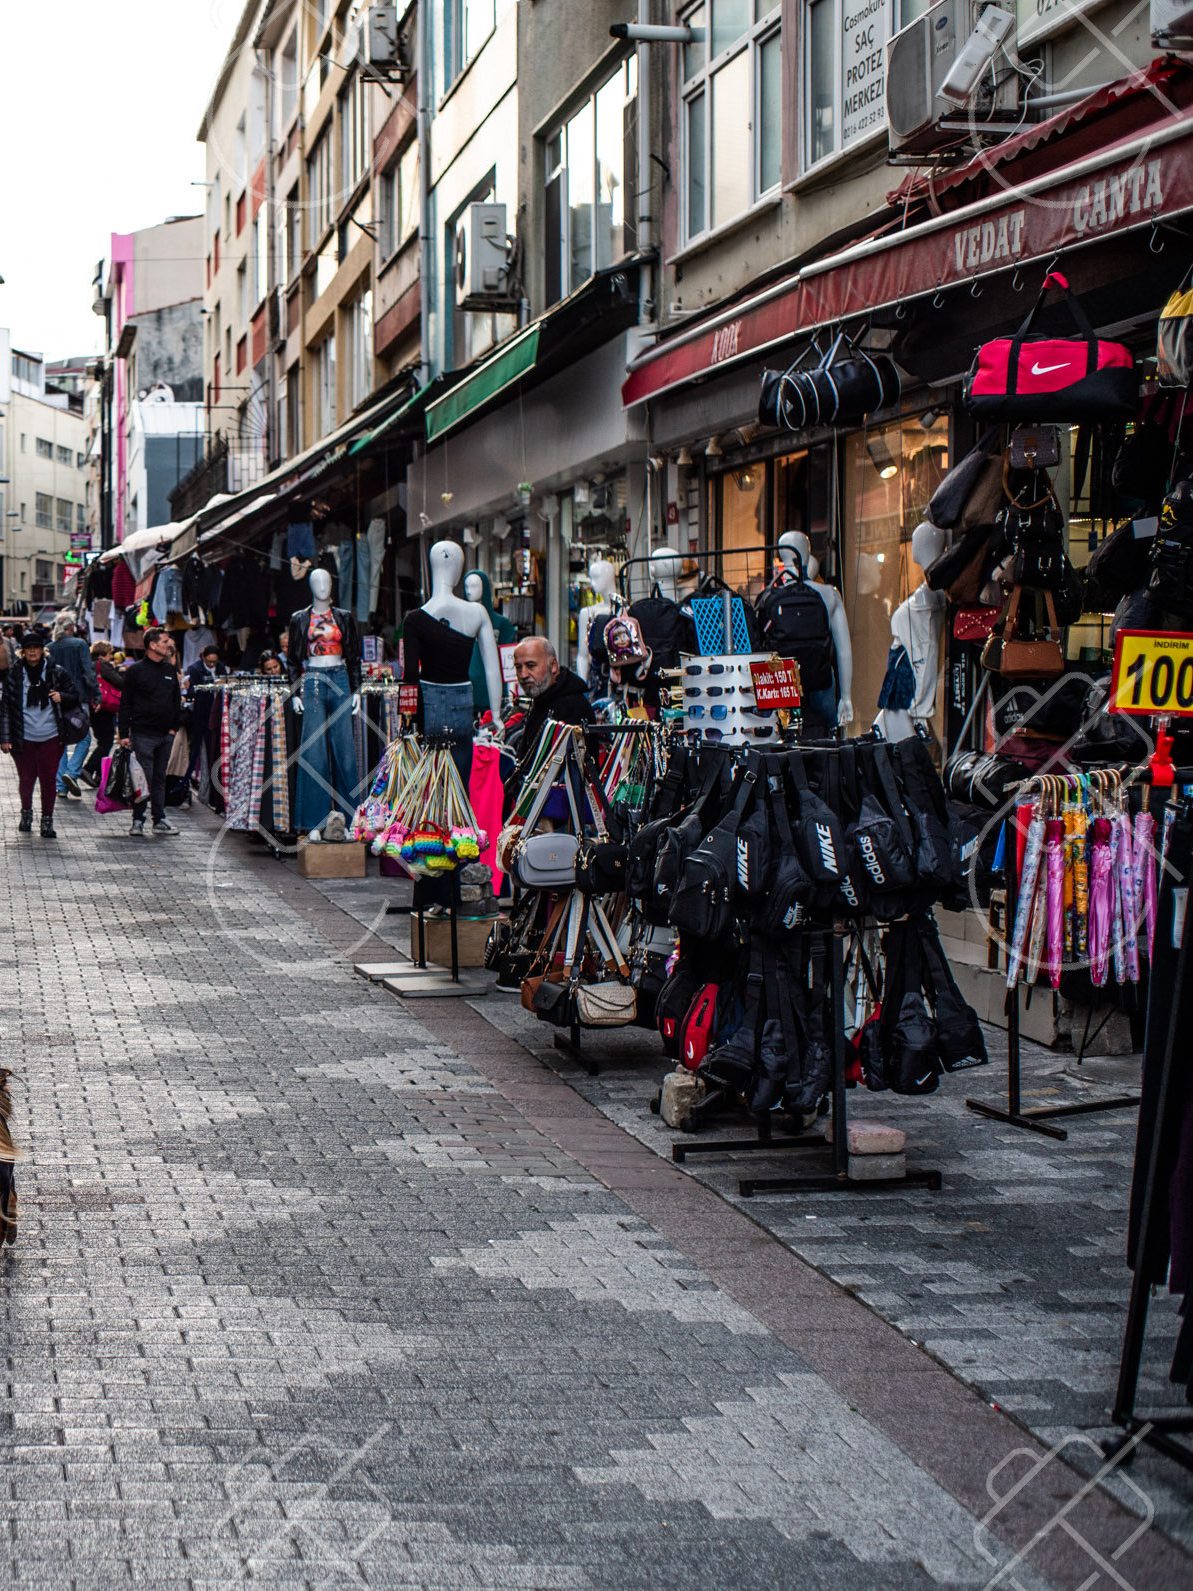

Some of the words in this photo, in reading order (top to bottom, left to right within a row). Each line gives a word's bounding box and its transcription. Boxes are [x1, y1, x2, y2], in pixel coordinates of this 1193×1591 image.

[855, 24, 874, 53] SAÇ
[847, 48, 882, 88] PROTEZ
[844, 71, 884, 118] MERKEZİ
[955, 209, 1025, 271] VEDAT
[1073, 159, 1163, 238] ÇANTA
[1154, 640, 1190, 649] İNDİRİM
[774, 670, 787, 683] 150
[780, 686, 790, 698] 165
[1127, 653, 1193, 708] 100
[737, 836, 749, 891] NIKE
[816, 822, 839, 874] NIKE
[859, 835, 886, 884] adidas
[960, 834, 979, 862] NIKE
